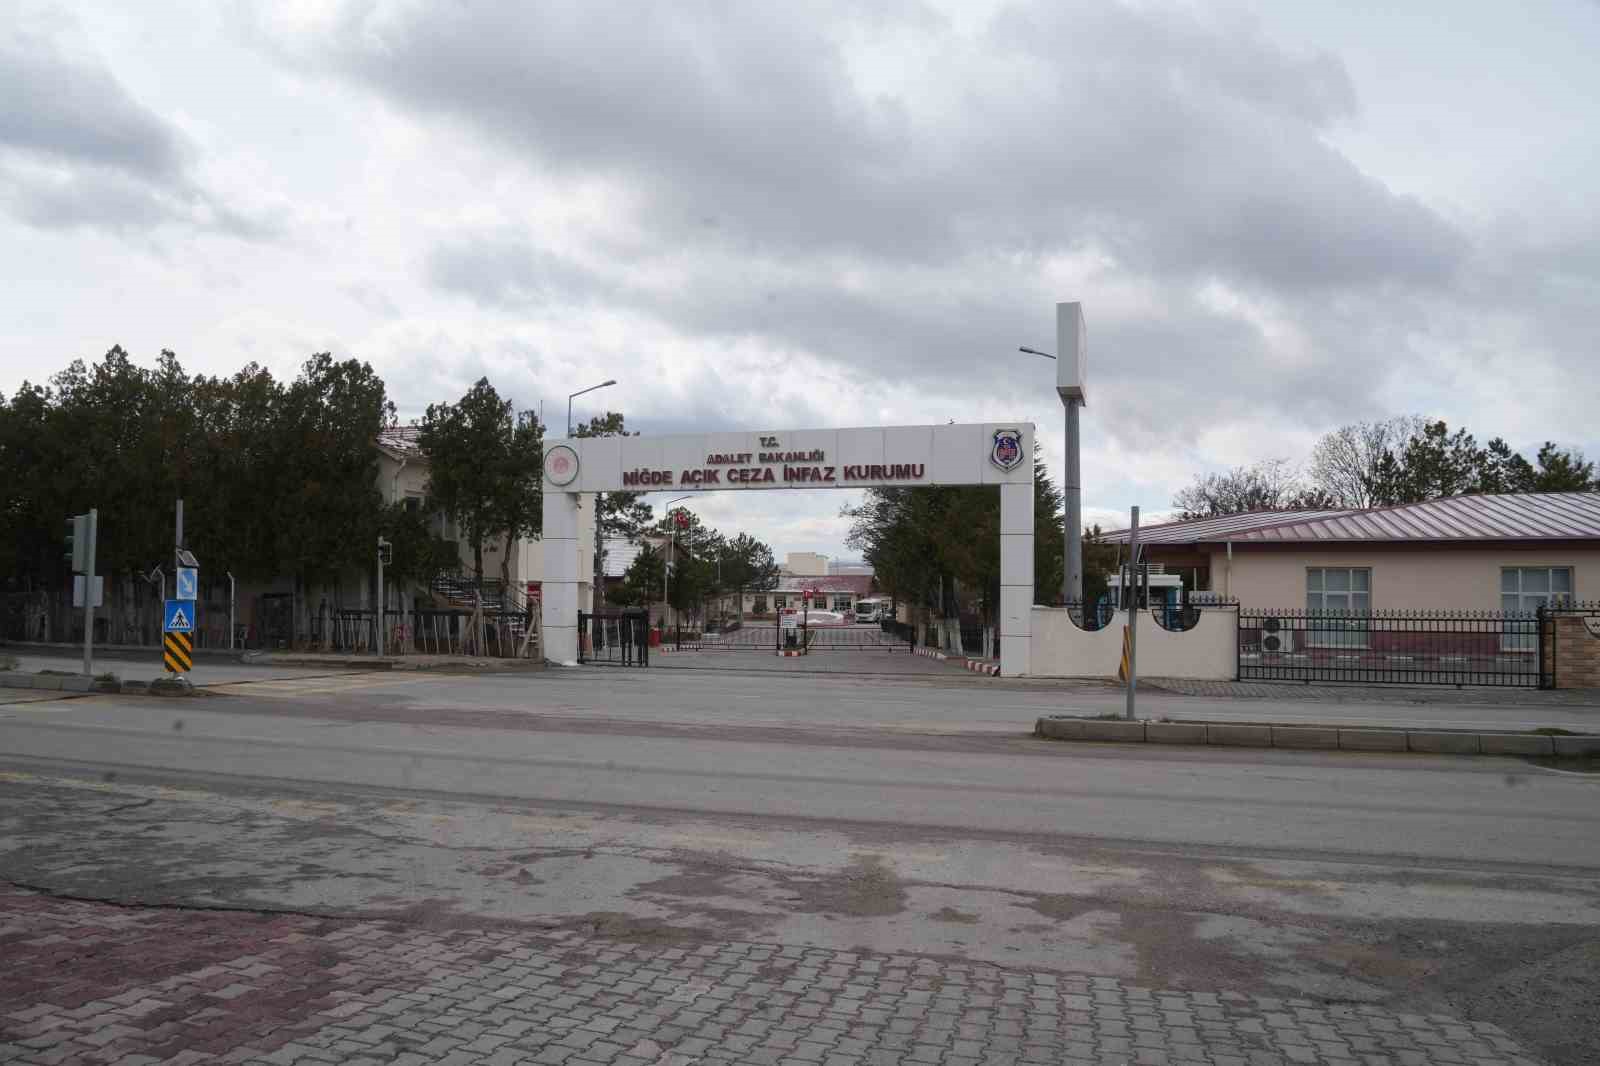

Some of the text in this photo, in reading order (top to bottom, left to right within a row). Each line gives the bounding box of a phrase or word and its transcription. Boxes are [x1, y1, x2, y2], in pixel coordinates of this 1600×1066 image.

[706, 449, 824, 465] ADALET BAKANLIĞI
[623, 467, 673, 485] NİĞDE
[727, 467, 775, 483] CEZA
[784, 464, 836, 482] İNFAZ
[844, 463, 925, 481] KURUMU
